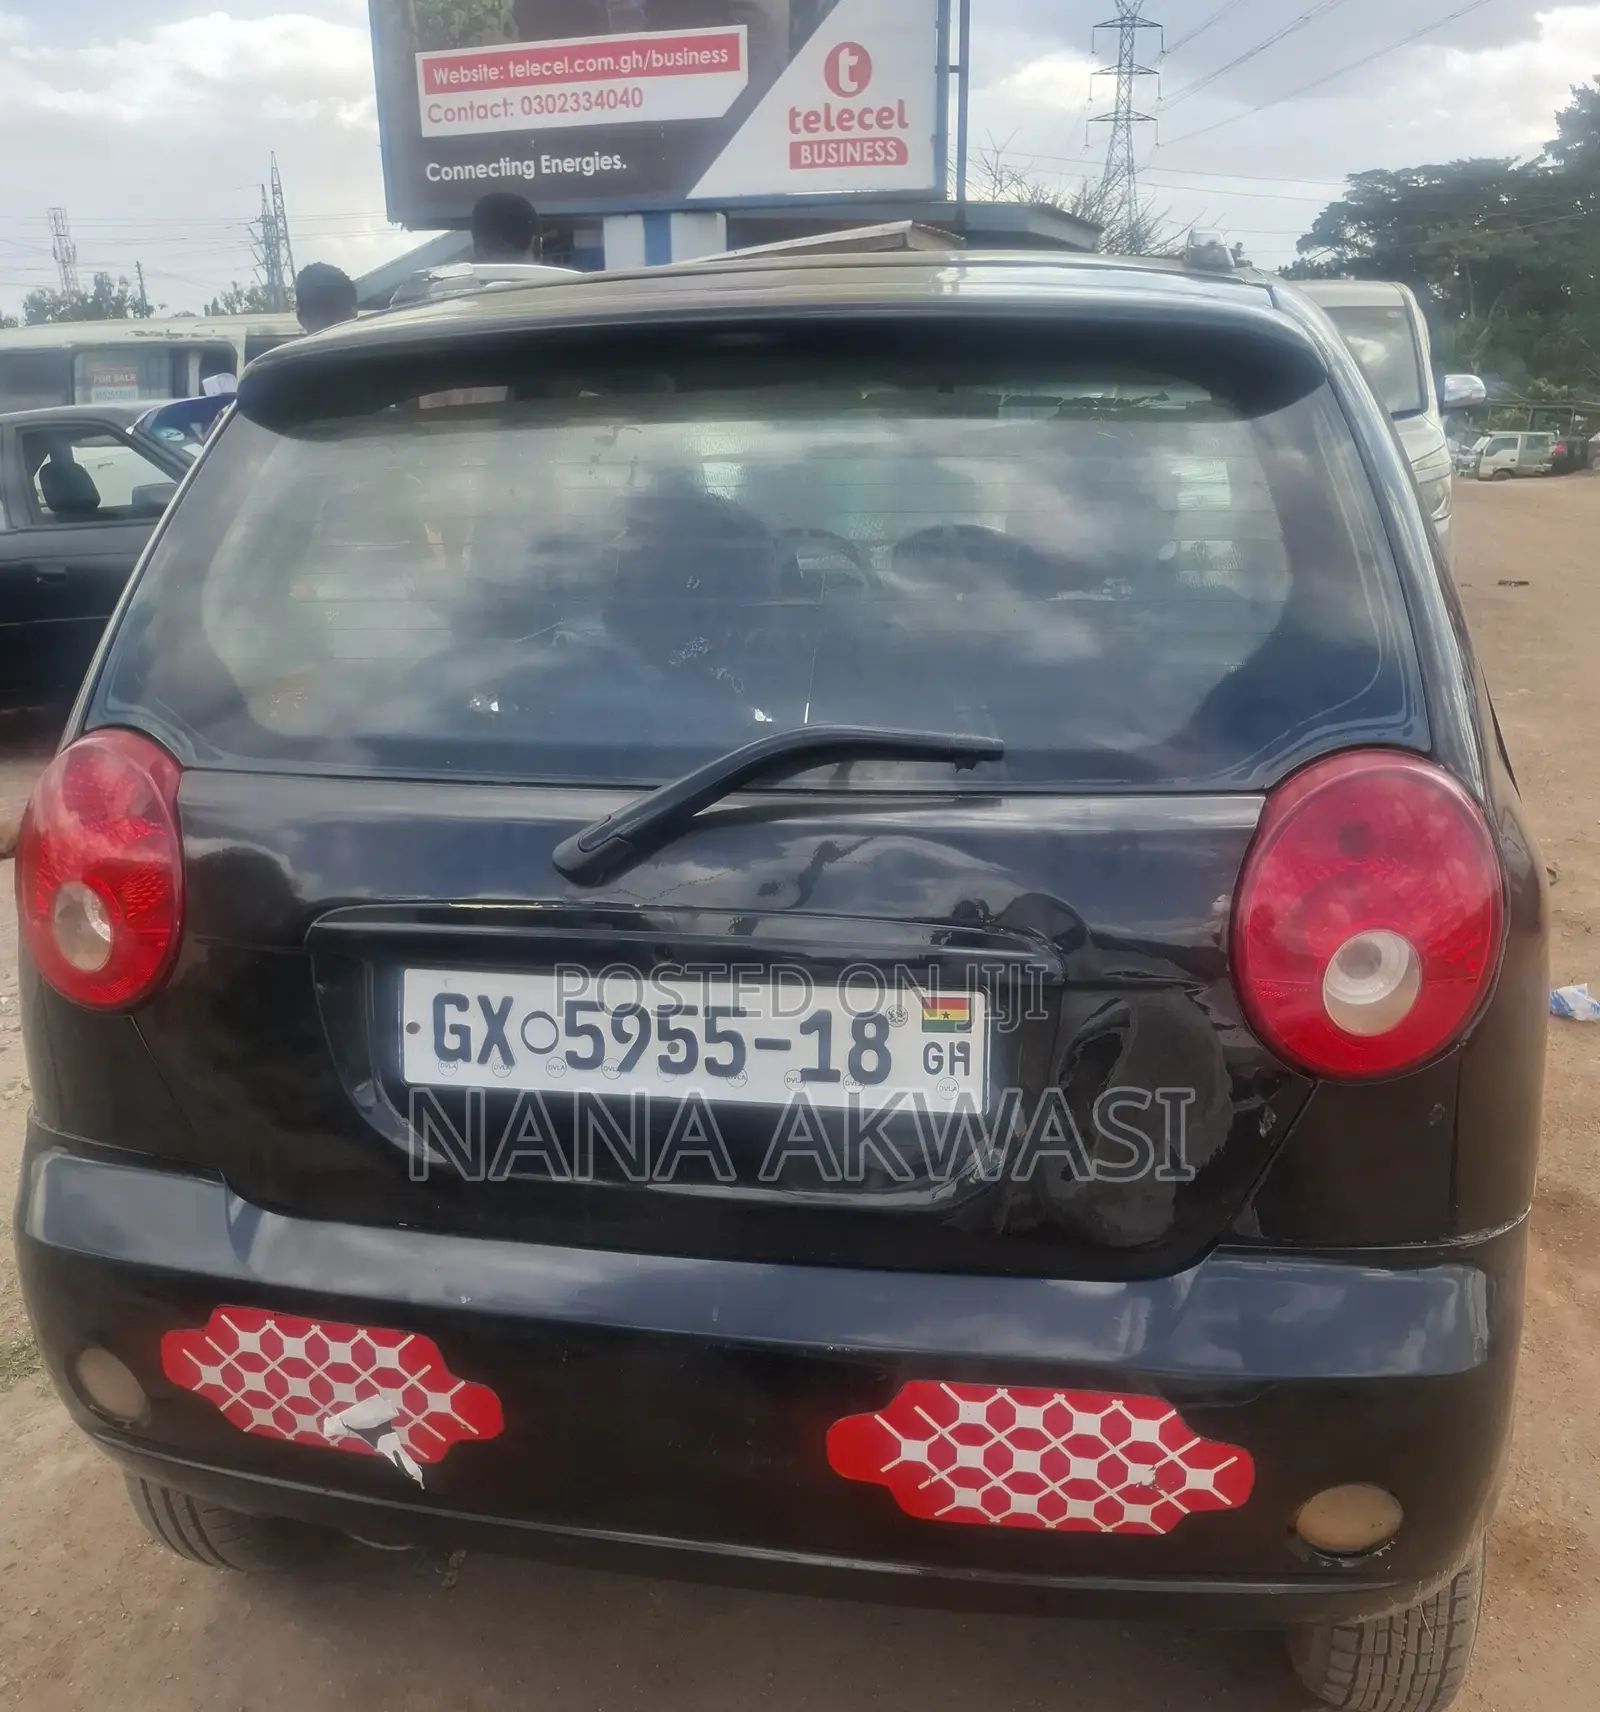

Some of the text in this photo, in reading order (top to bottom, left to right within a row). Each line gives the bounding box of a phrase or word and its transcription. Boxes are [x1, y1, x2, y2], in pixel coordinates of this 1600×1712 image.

[432, 46, 729, 86] Website: telecel.com.gh/business
[838, 47, 859, 93] t
[427, 87, 644, 124] Contact: 0302334040
[788, 98, 910, 135] telecel
[425, 150, 628, 183] Connecting Energies.
[799, 140, 898, 165] BUSINESS
[93, 373, 137, 383] FOR SALE
[433, 993, 892, 1085] GX 5955-18
[922, 1041, 971, 1077] GH
